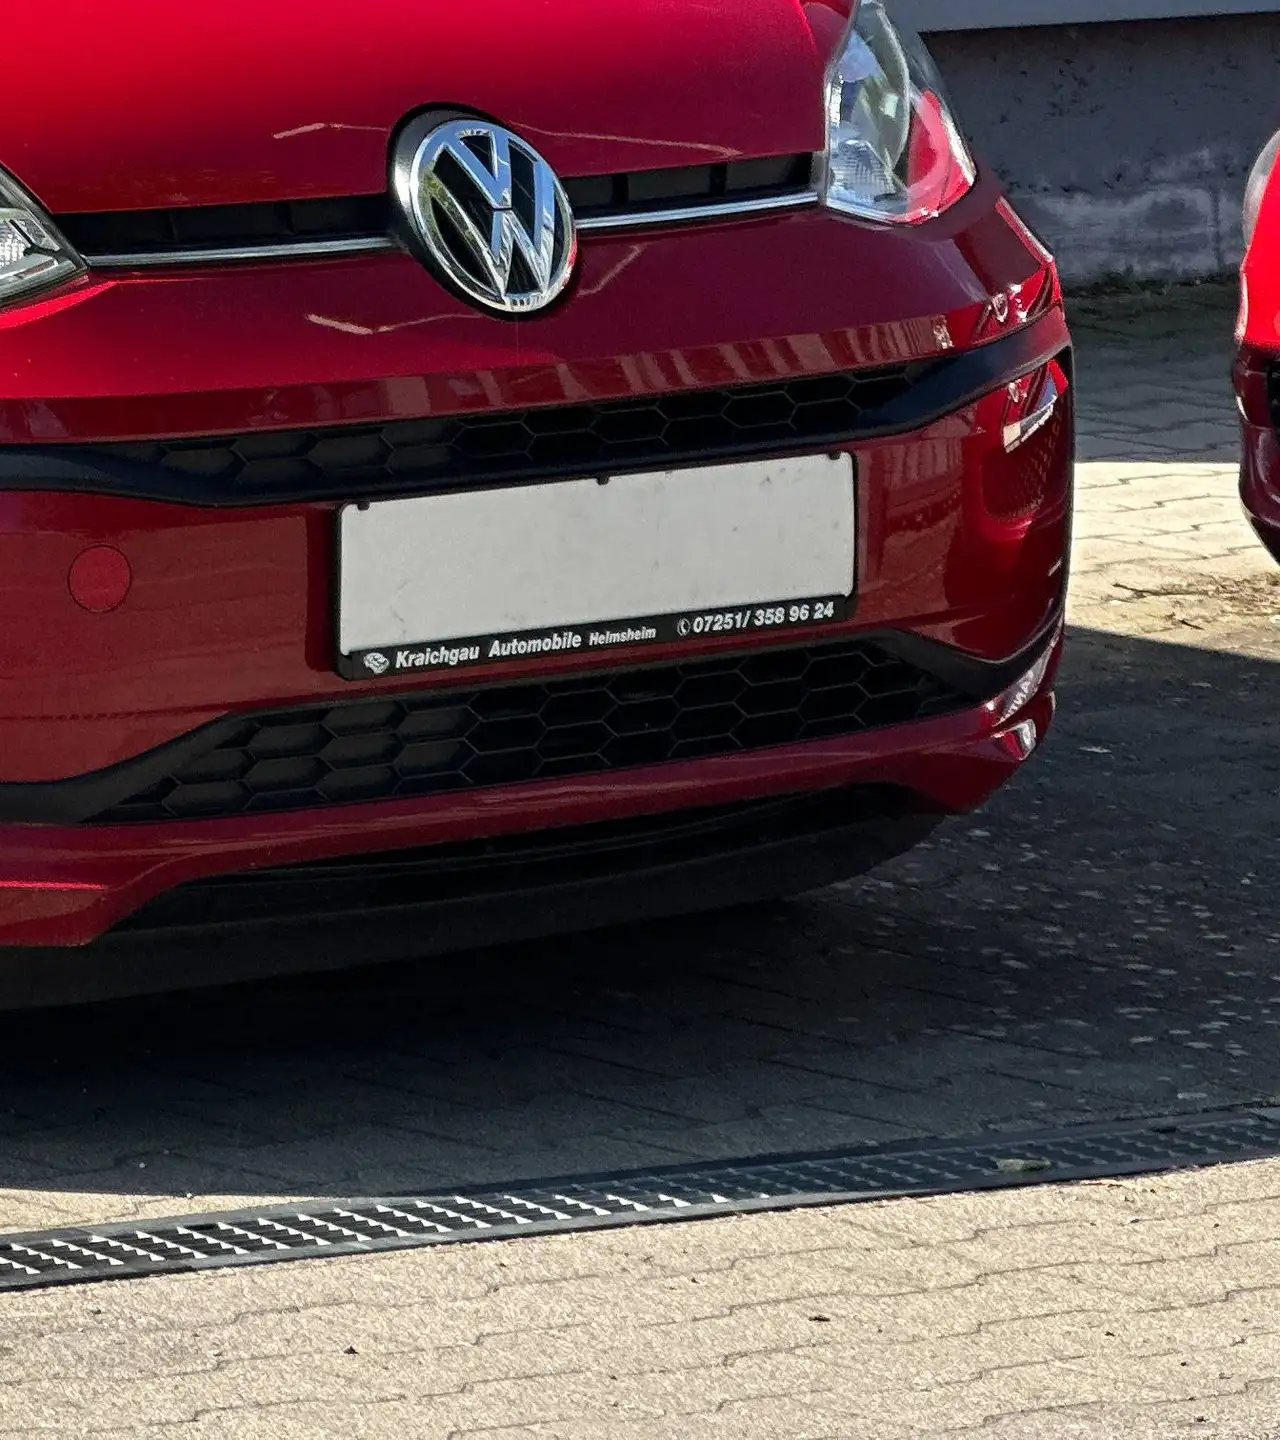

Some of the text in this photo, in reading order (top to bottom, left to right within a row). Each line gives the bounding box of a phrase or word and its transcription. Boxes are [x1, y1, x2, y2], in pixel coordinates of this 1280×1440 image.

[395, 601, 835, 669] Kraichgau Automobile Helmsheim 07251/ 358 96 24
